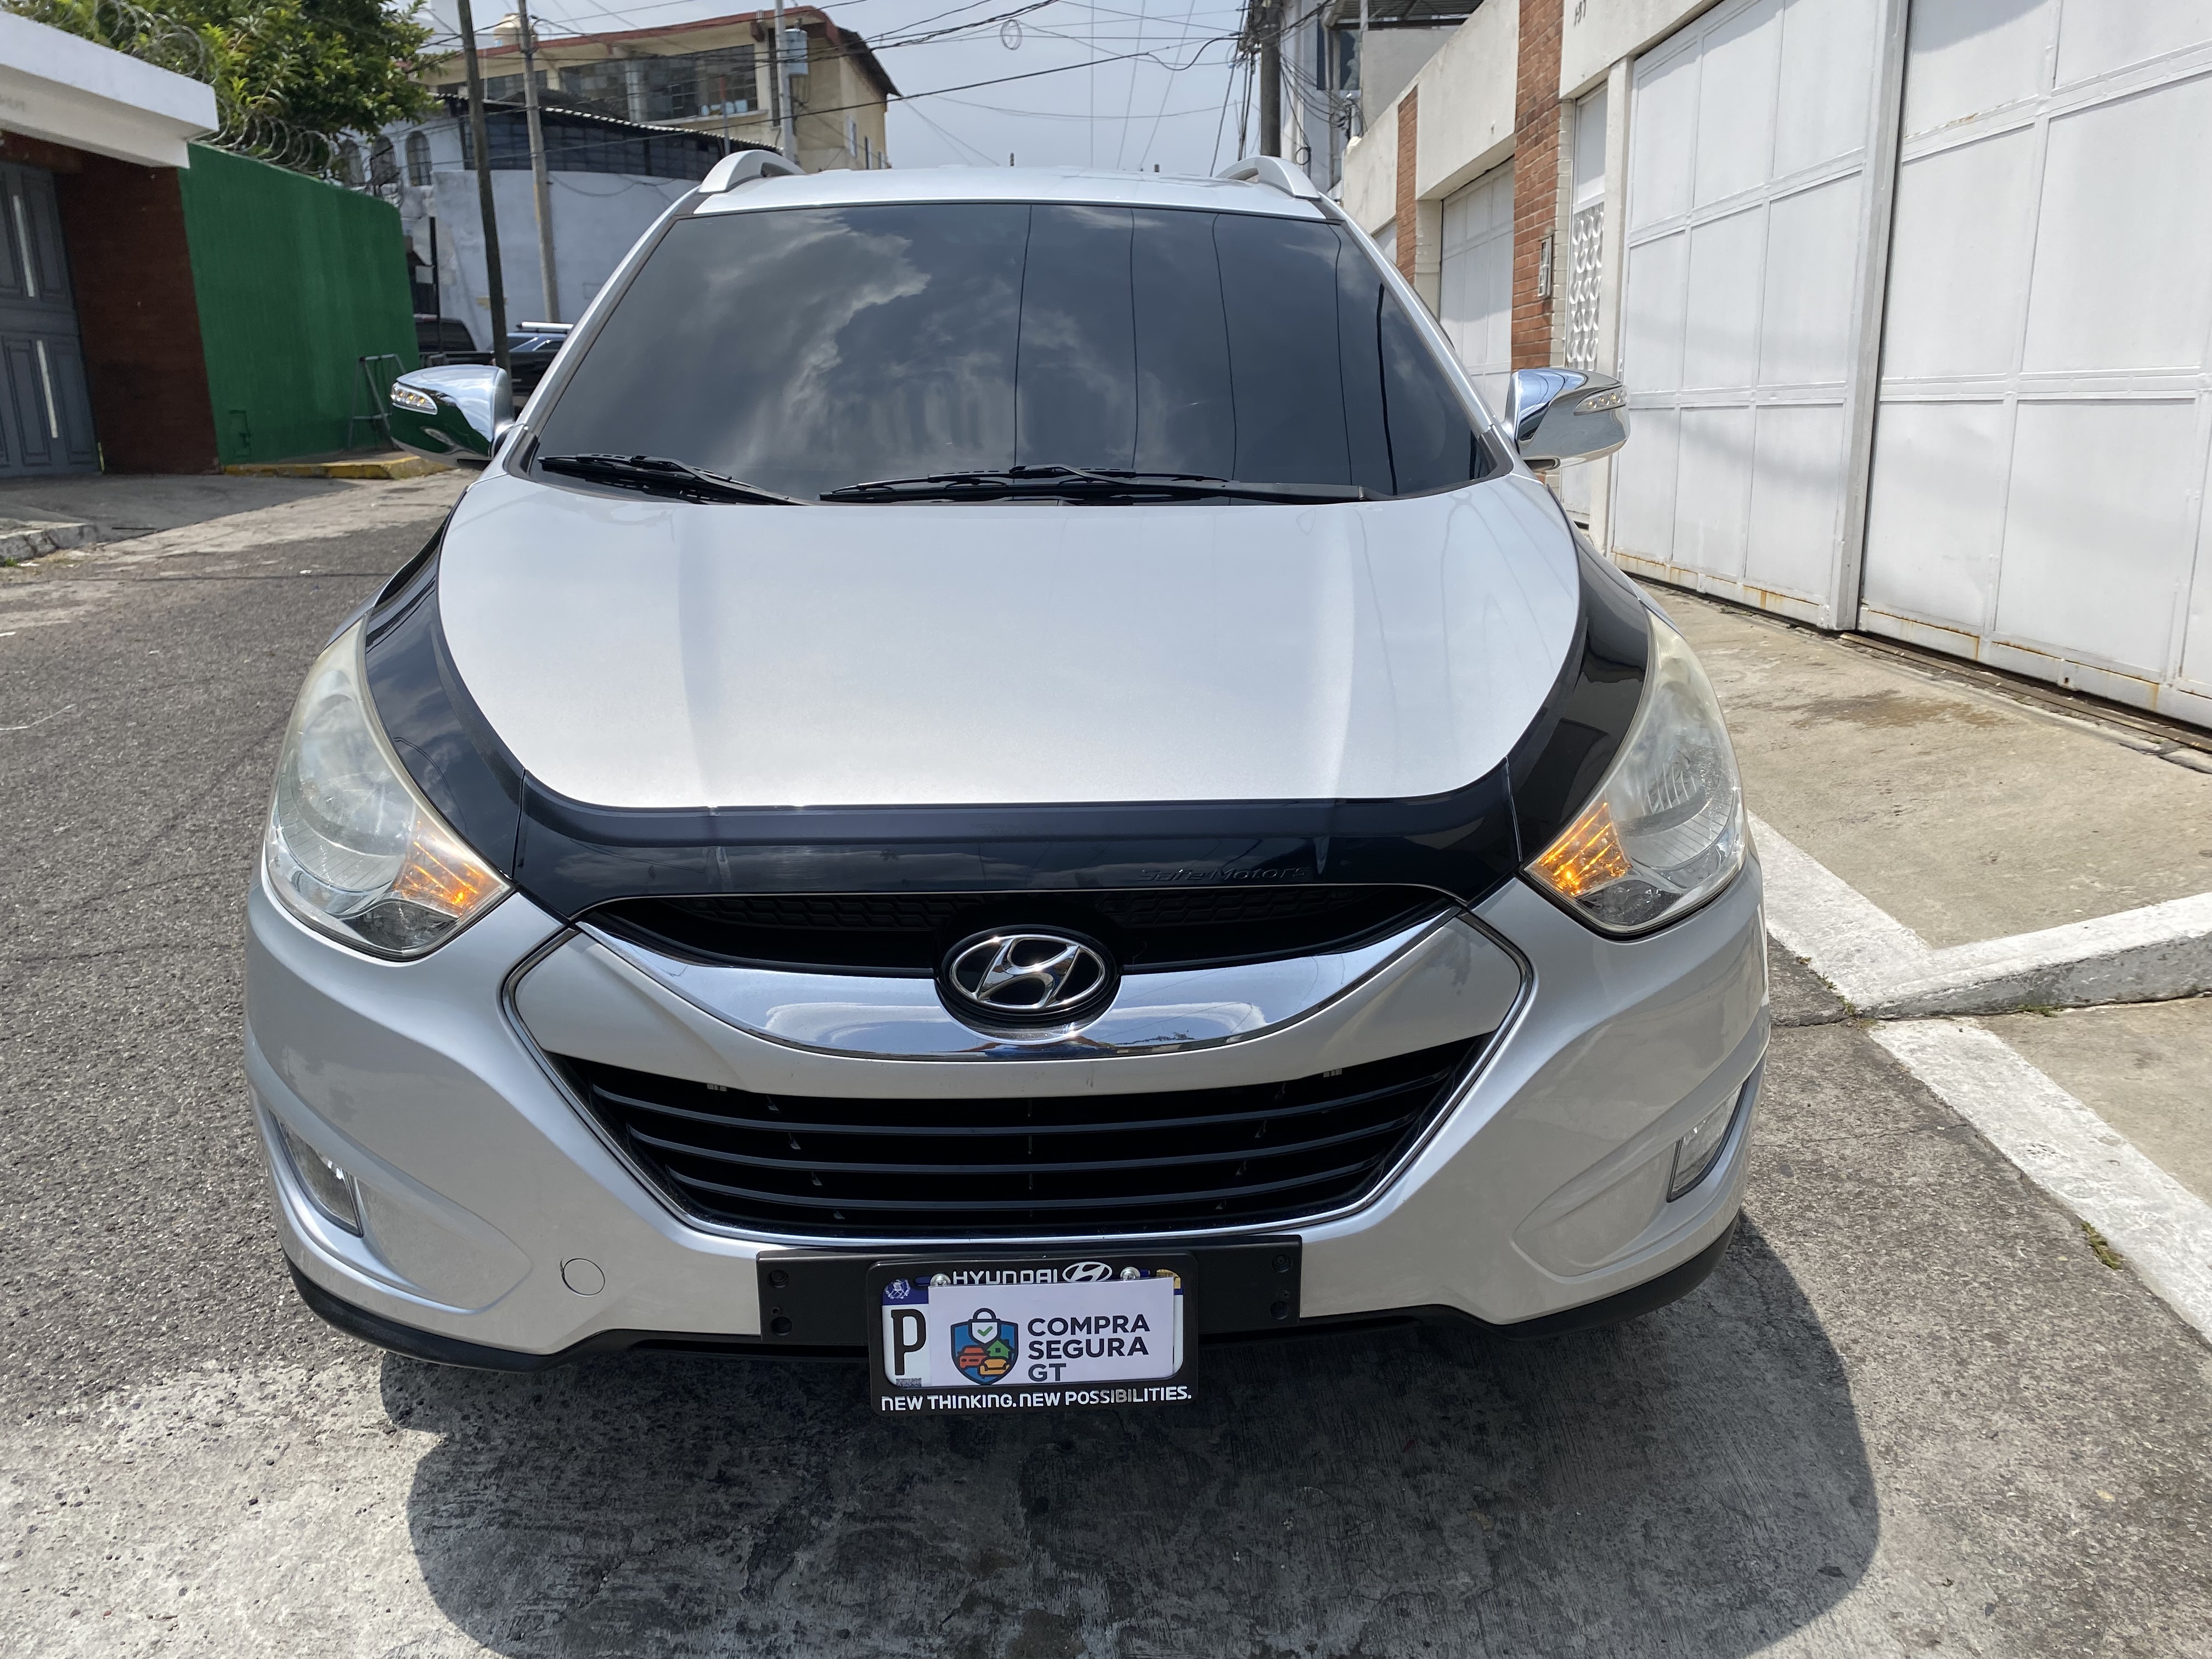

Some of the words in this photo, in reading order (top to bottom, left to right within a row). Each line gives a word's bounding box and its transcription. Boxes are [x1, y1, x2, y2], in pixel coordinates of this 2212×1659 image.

[952, 1268, 1058, 1285] HYUNDAI
[1027, 1314, 1151, 1336] COMPRA
[891, 1308, 927, 1376] P
[1028, 1336, 1149, 1360] SEGURA
[1028, 1363, 1066, 1382] GT
[881, 1395, 923, 1411] NEW
[1065, 1385, 1192, 1406] POSSIBILITIES.
